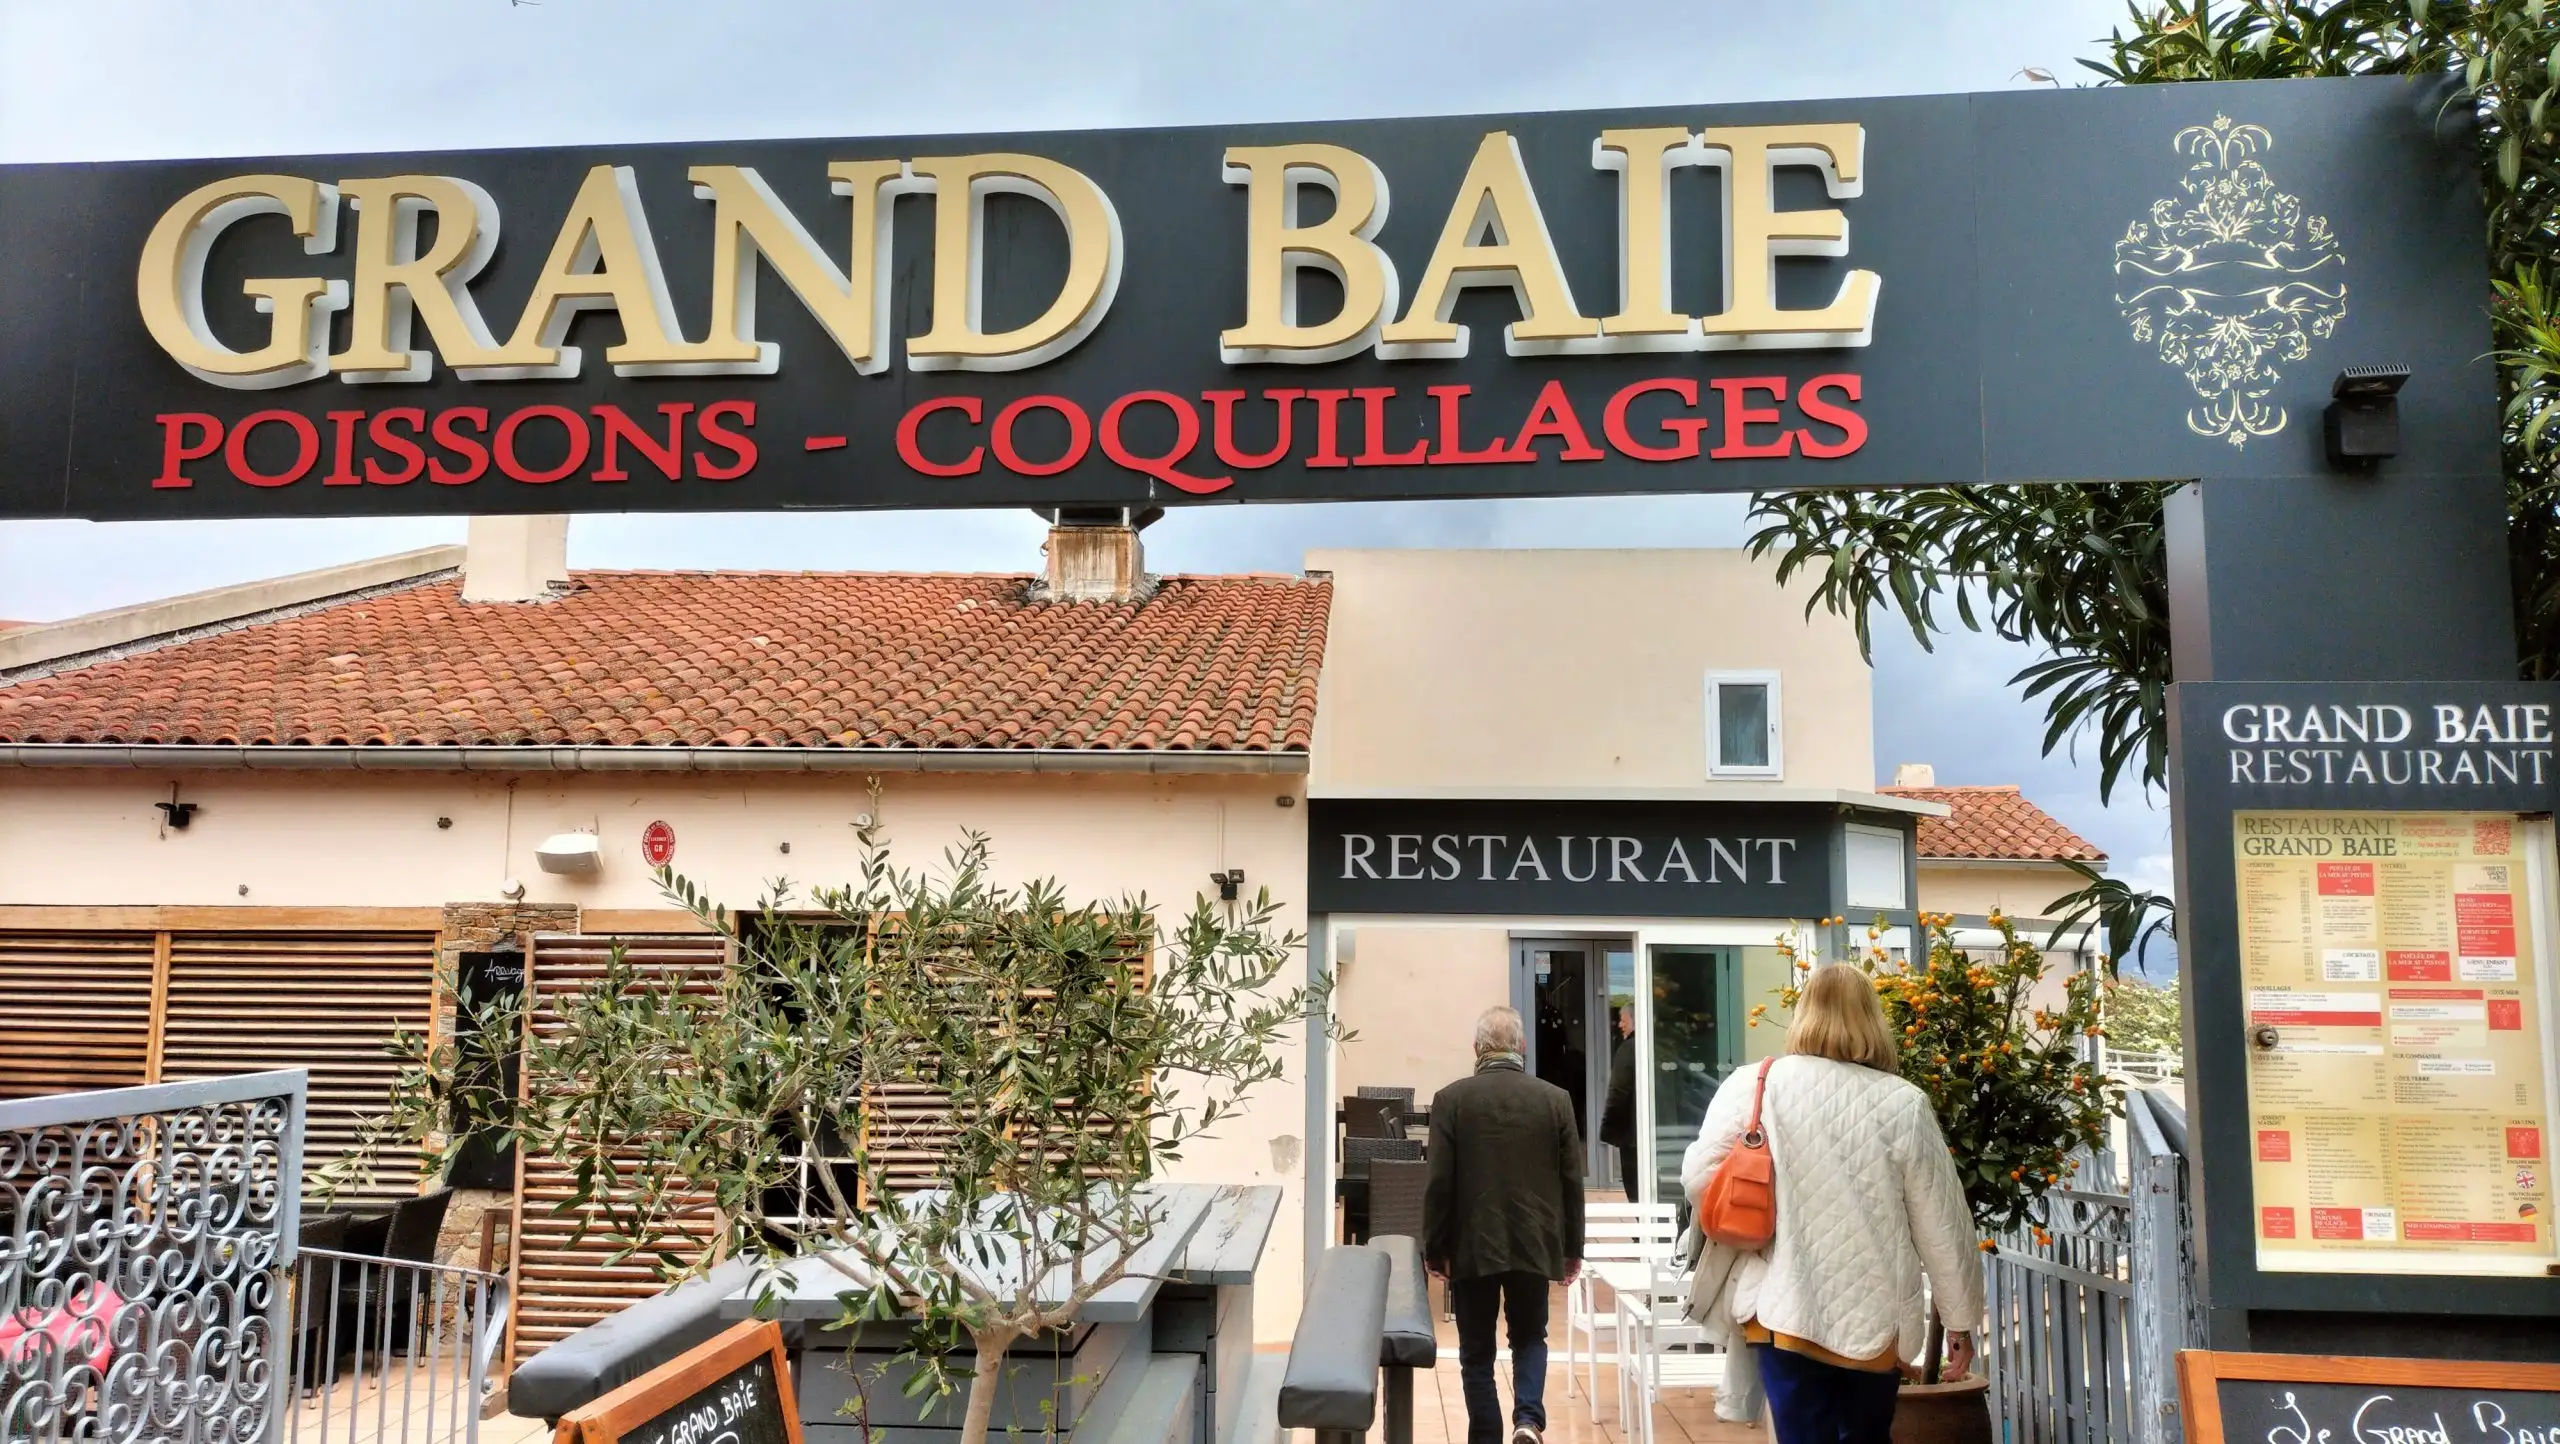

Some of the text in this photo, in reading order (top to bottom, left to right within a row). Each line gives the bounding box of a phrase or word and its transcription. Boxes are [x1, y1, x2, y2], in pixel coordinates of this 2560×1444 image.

[137, 122, 1882, 390] GRAND BAIE
[152, 400, 758, 489] POISSONS
[895, 373, 1868, 494] COQUILLAGES
[2222, 703, 2553, 744] GRAND BAIE
[2229, 748, 2553, 785] RESTAURANT
[2243, 817, 2396, 835] RESTAURANT
[1338, 832, 1797, 885] RESTAURANT
[2243, 837, 2333, 856] GRAND
[2342, 837, 2397, 857] BAIE
